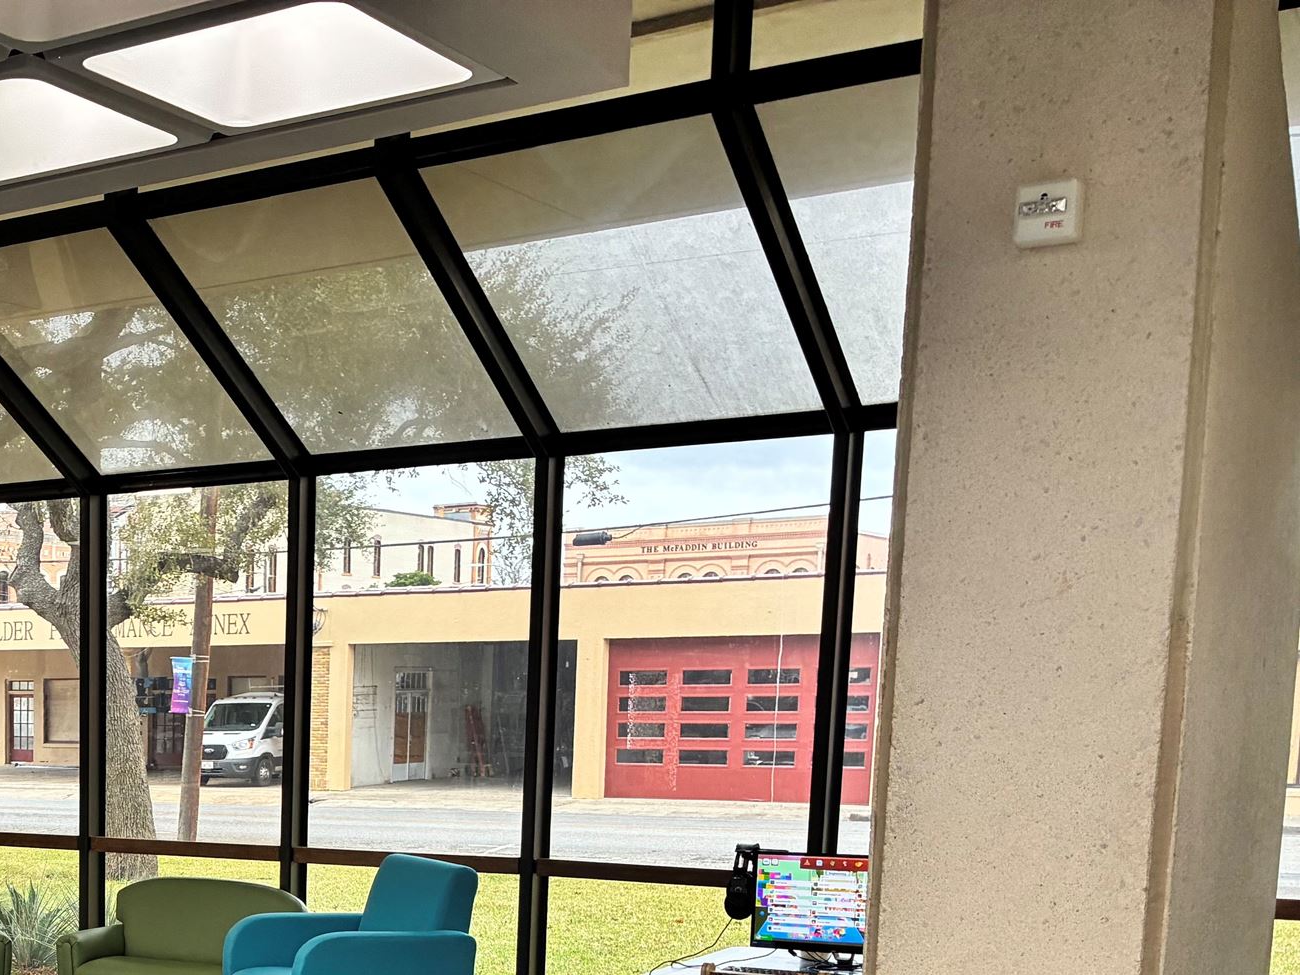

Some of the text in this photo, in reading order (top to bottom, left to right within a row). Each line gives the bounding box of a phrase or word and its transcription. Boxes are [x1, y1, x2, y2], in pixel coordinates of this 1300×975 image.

[1044, 220, 1064, 229] FIRE
[663, 543, 708, 552] McFADDIN
[712, 541, 758, 550] BUILDING
